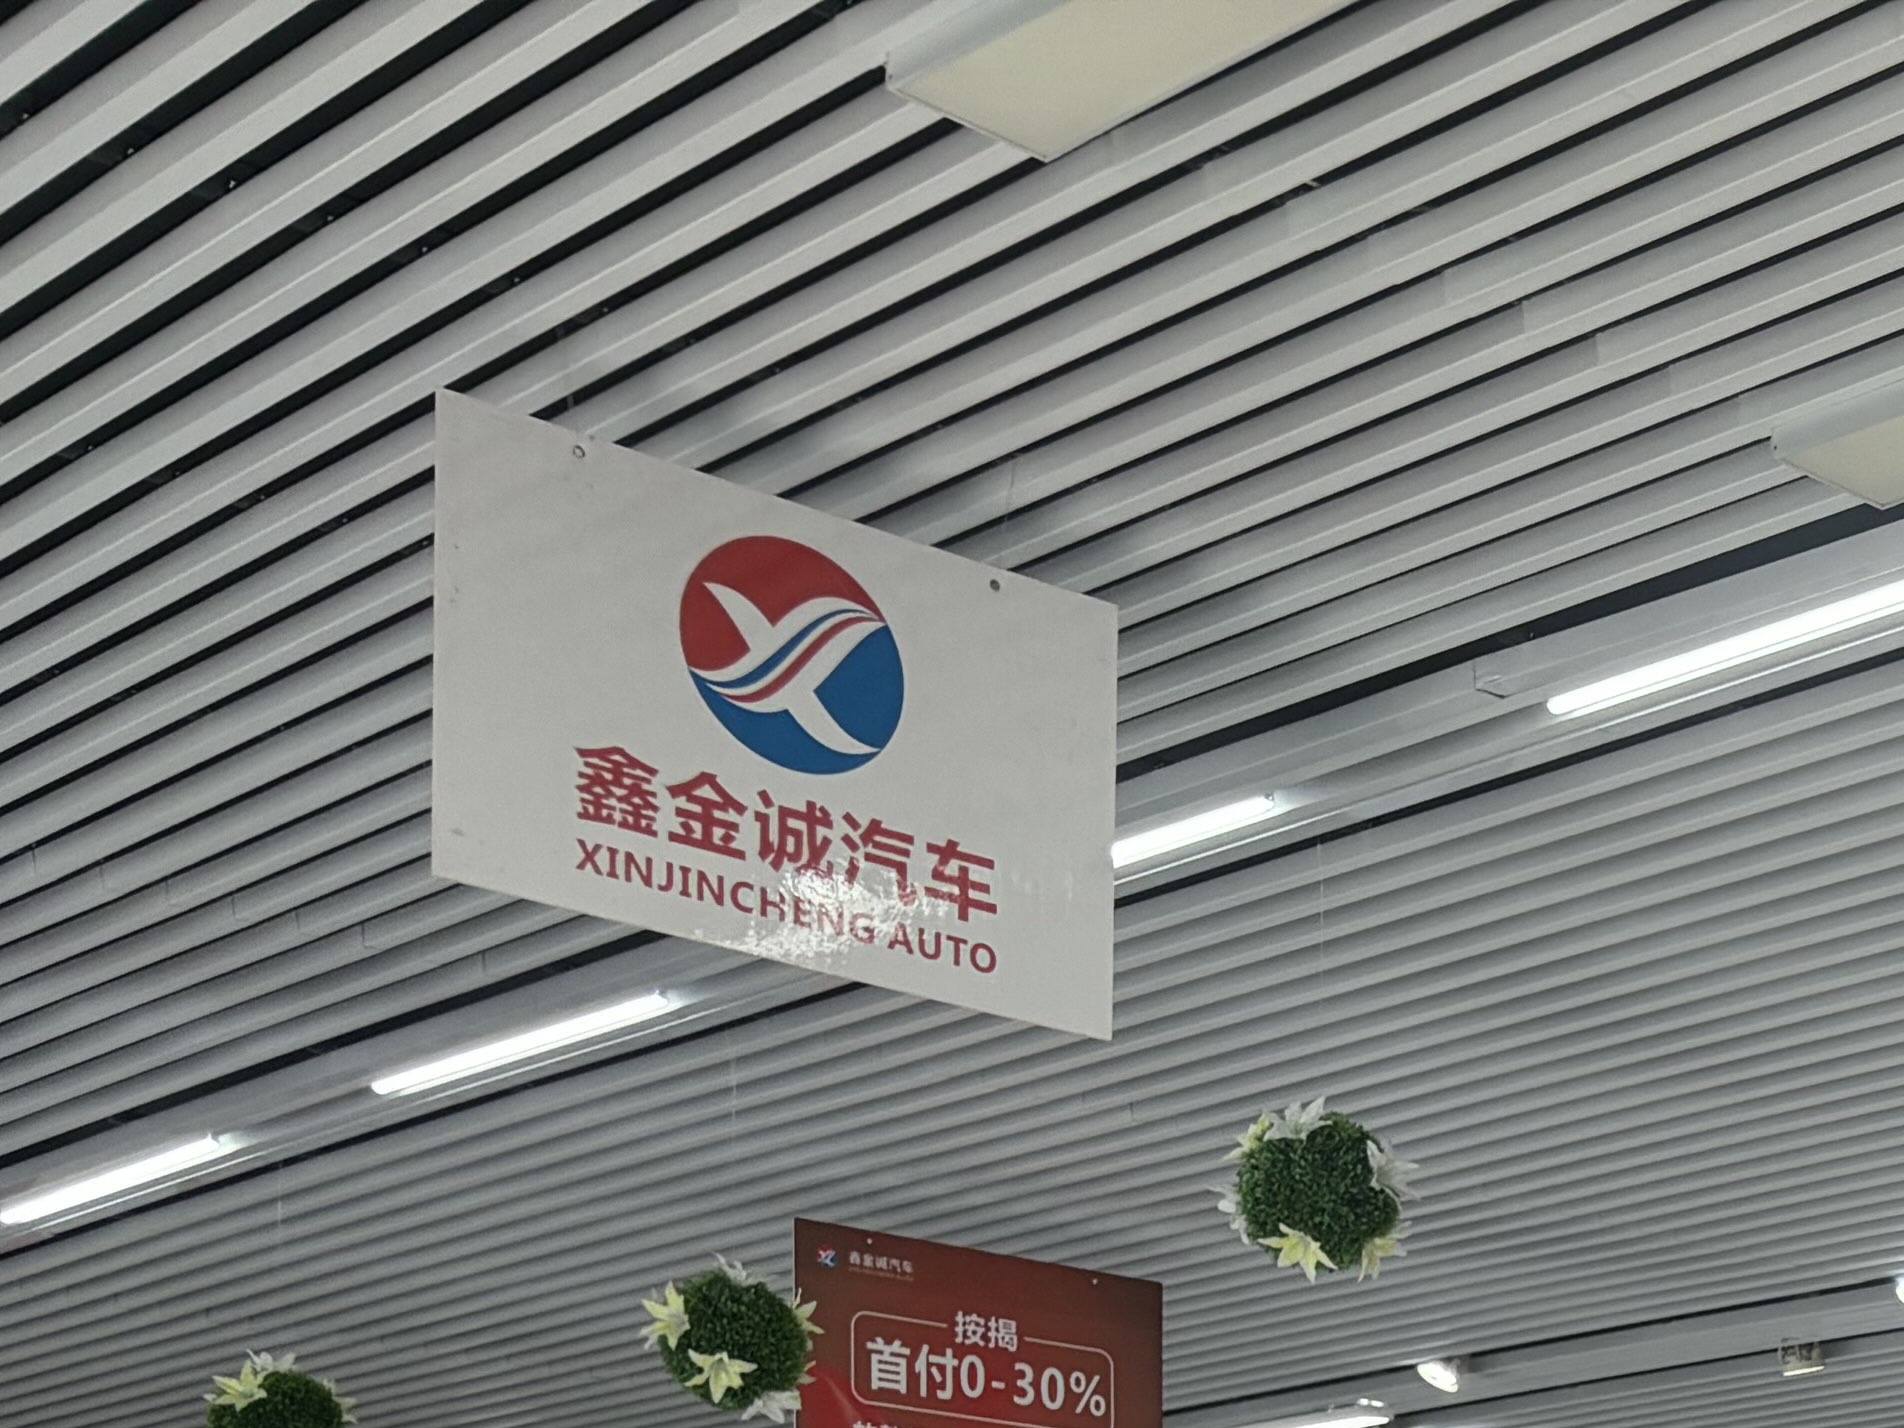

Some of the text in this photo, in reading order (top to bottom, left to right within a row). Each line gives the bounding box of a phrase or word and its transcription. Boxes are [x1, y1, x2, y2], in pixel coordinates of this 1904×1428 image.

[572, 745, 998, 922] 鑫金诚汽车
[575, 838, 998, 974] XINJINCHENG AUTO
[866, 1336, 1107, 1417] 首付0-30%
[954, 1310, 1019, 1352] 按揭
